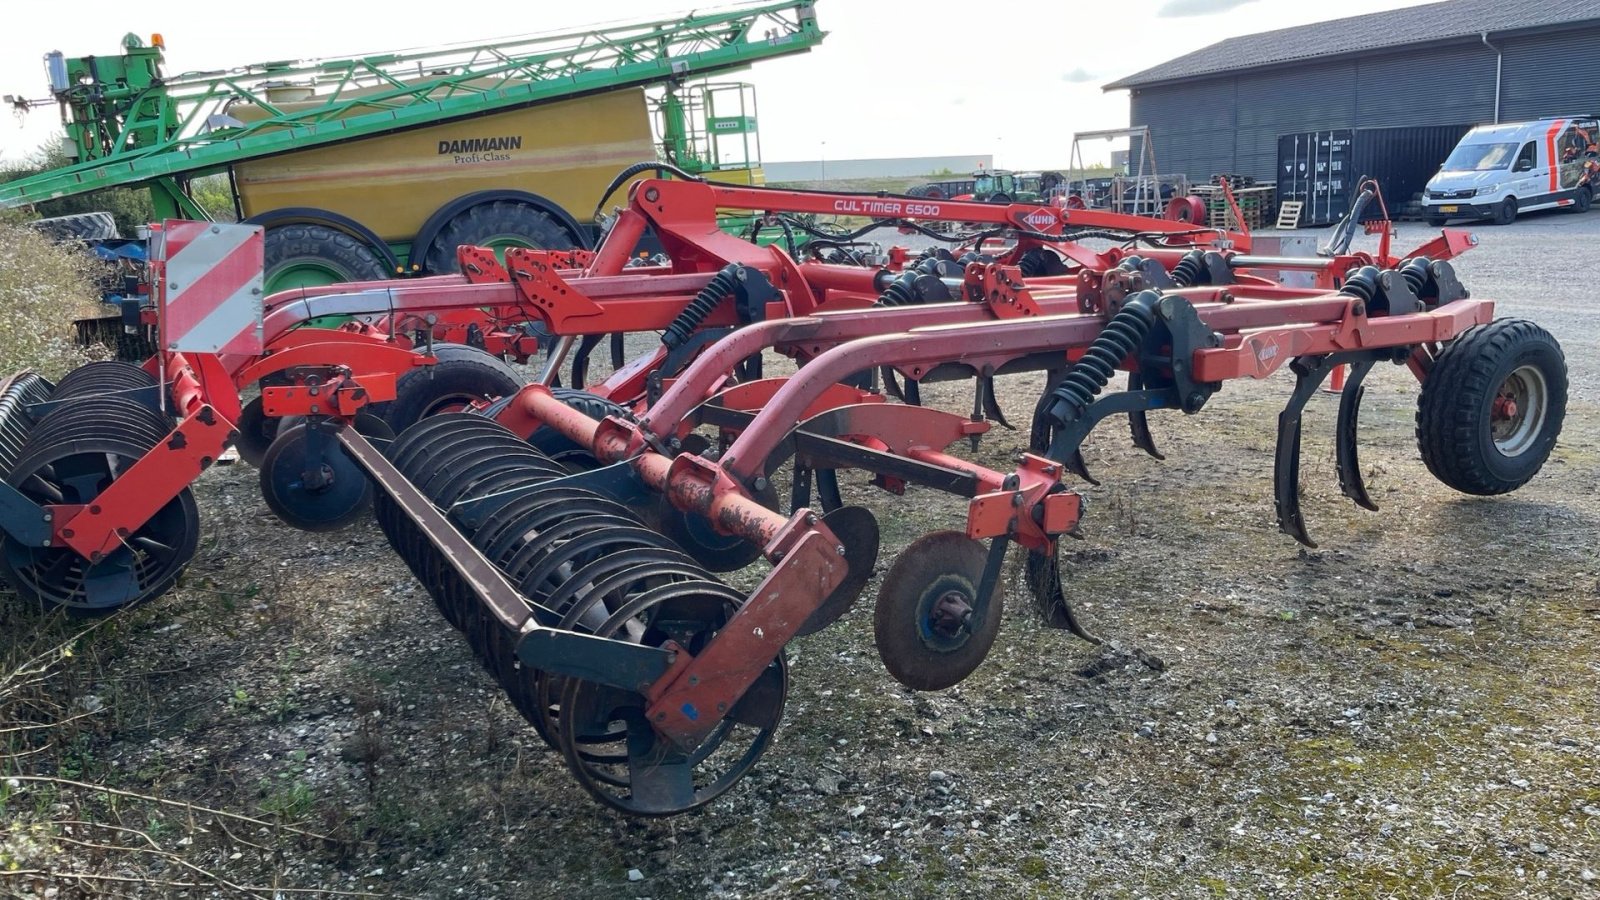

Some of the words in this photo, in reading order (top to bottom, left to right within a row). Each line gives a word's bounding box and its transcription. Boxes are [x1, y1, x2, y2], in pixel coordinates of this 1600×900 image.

[438, 136, 522, 154] DAMMANN
[454, 152, 511, 163] Profi-Class
[834, 200, 902, 213] CULTIMER
[905, 204, 940, 216] 6500
[1028, 215, 1056, 225] KUHN
